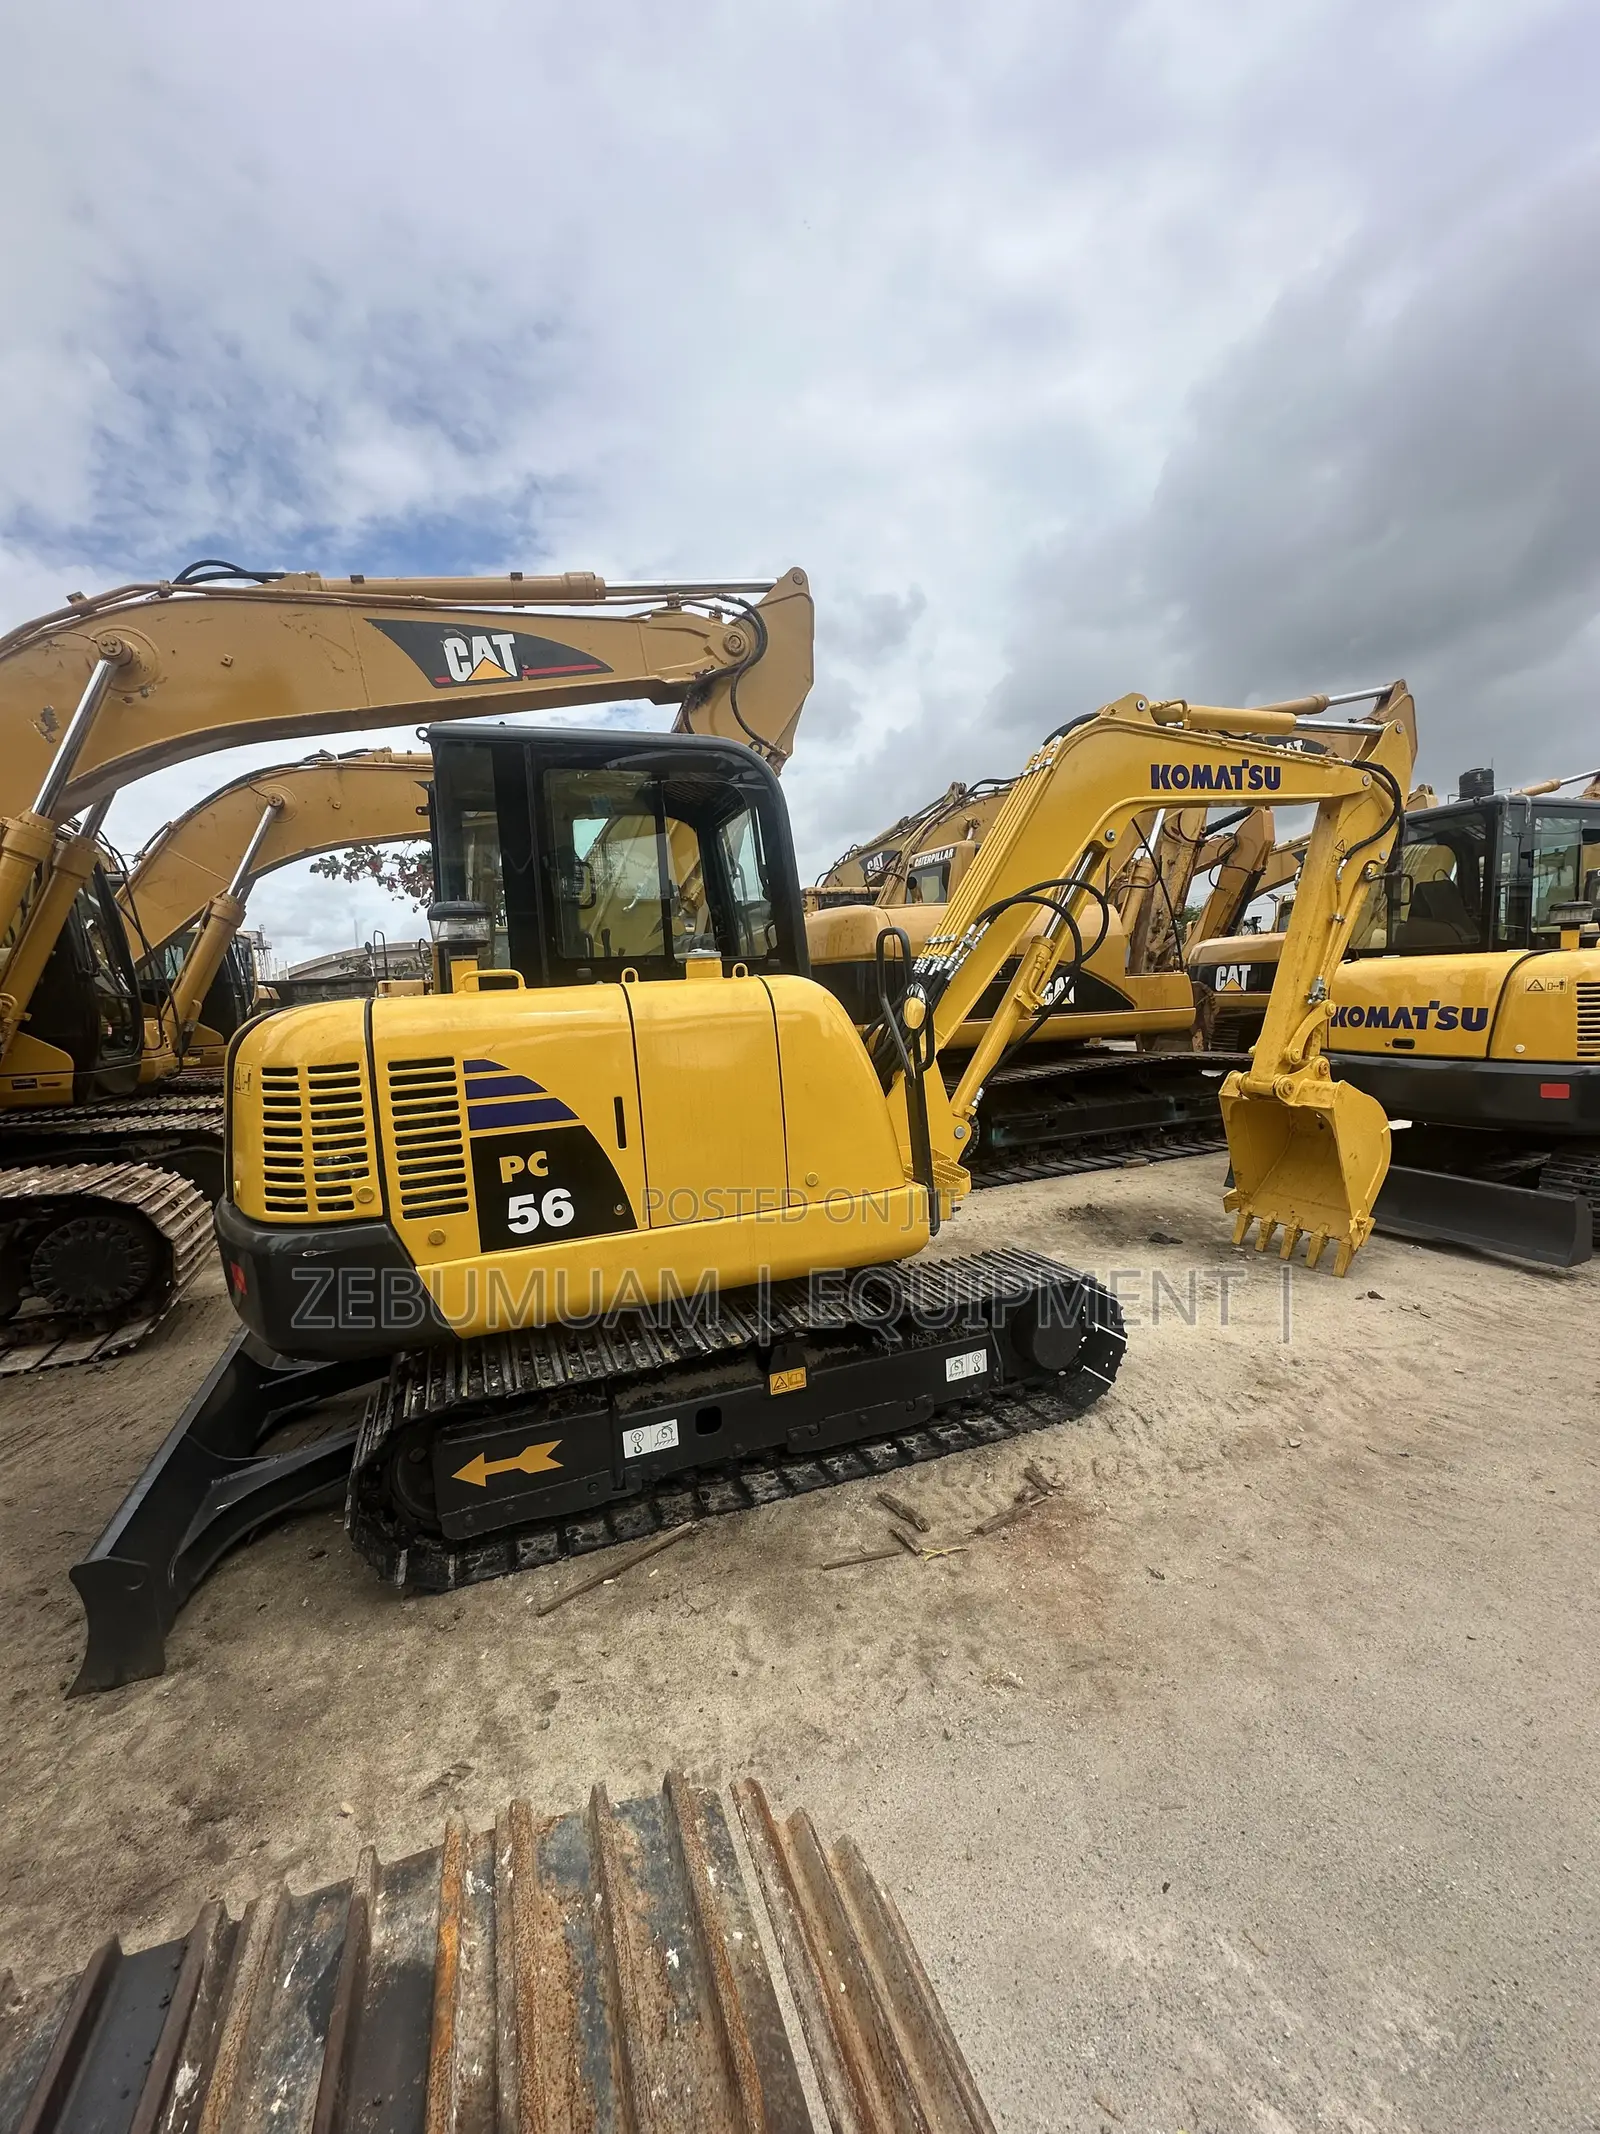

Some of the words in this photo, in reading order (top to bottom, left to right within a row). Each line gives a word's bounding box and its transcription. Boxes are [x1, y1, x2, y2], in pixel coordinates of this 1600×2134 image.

[443, 633, 518, 682] CAT
[1150, 759, 1281, 790] KOMATSU
[867, 852, 883, 876] CAT
[914, 848, 954, 868] CATERPILLAR
[1215, 965, 1251, 991] CAT
[1330, 1000, 1489, 1032] KOMATSU
[499, 1150, 549, 1184] PC
[507, 1188, 575, 1234] 56
